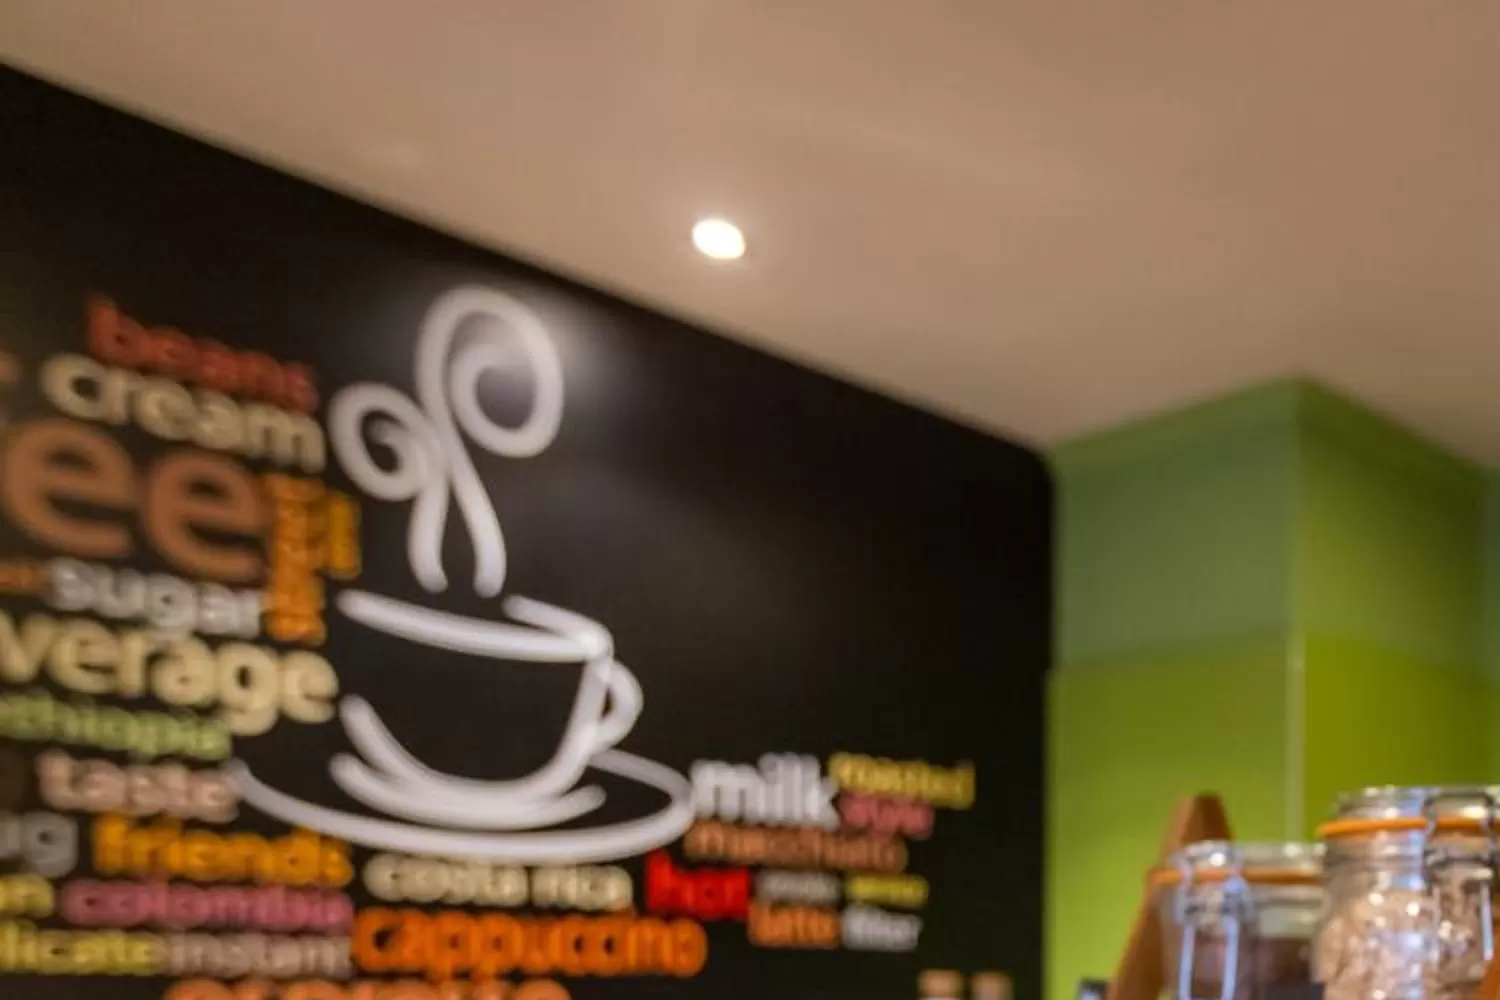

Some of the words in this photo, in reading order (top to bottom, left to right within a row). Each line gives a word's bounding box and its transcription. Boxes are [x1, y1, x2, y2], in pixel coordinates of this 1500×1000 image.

[86, 296, 318, 412] beans
[42, 354, 327, 474] cream
[50, 556, 262, 642] sugar
[0, 612, 340, 736] verage
[38, 750, 240, 822] taste
[690, 752, 838, 830] milk
[94, 812, 354, 888] friends
[350, 906, 709, 984] cappuccino
